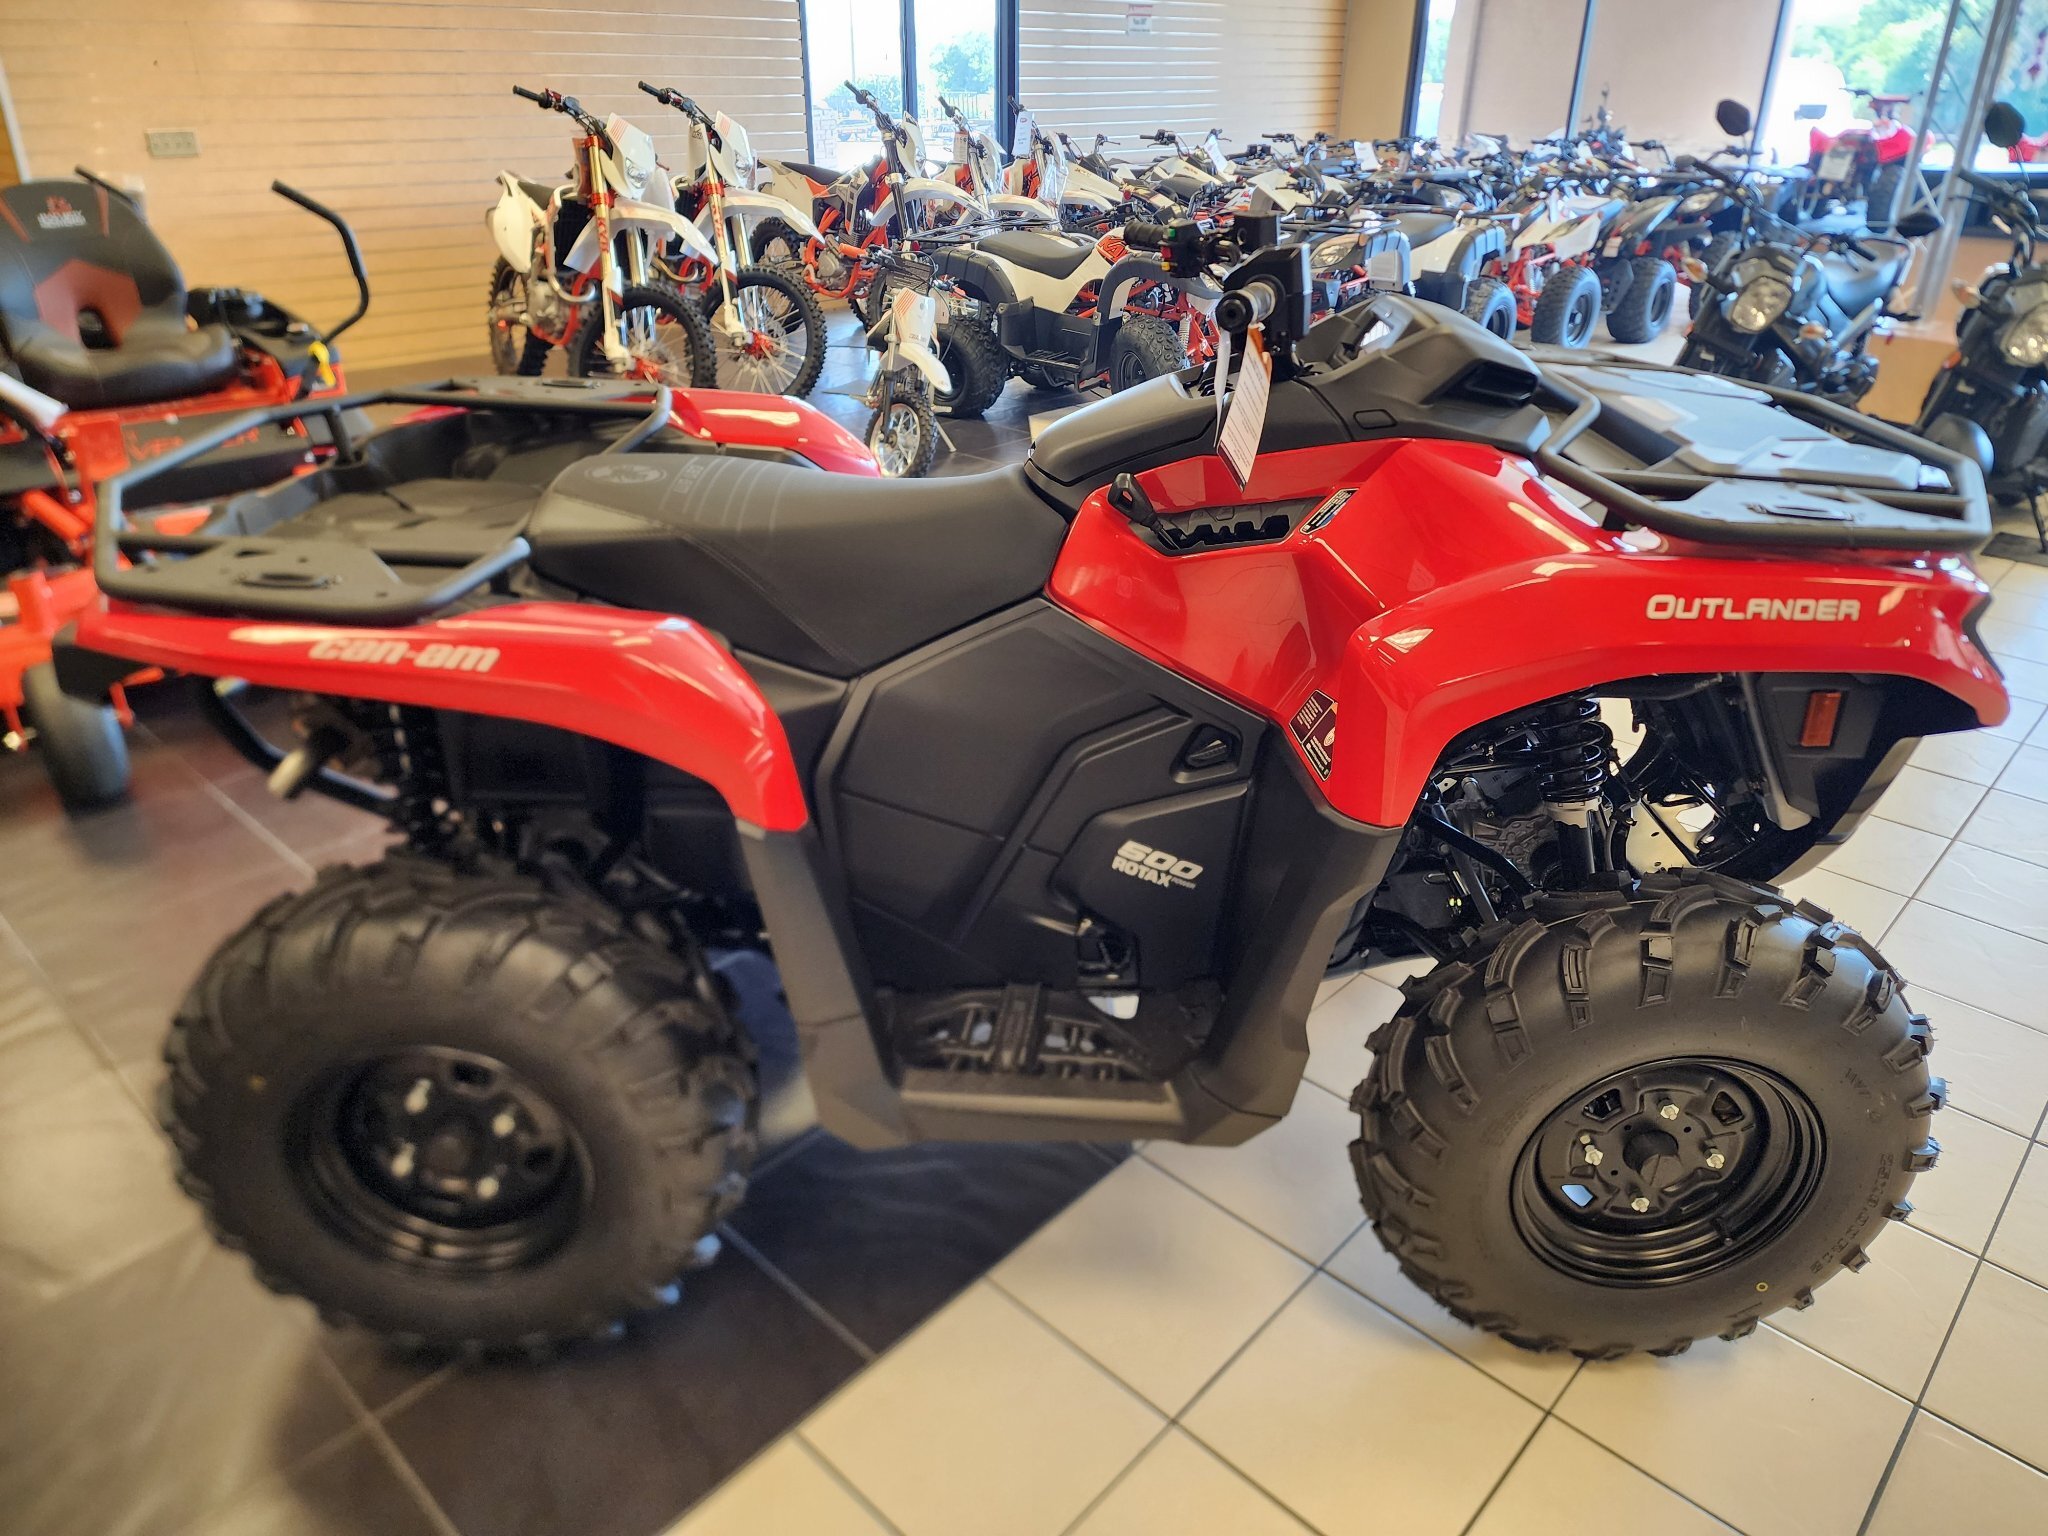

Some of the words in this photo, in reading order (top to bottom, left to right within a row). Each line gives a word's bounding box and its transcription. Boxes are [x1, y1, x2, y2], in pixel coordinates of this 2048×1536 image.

[1646, 594, 1861, 621] OUTLANDER
[1111, 855, 1172, 888] ROTAX
[1117, 840, 1203, 880] 500
